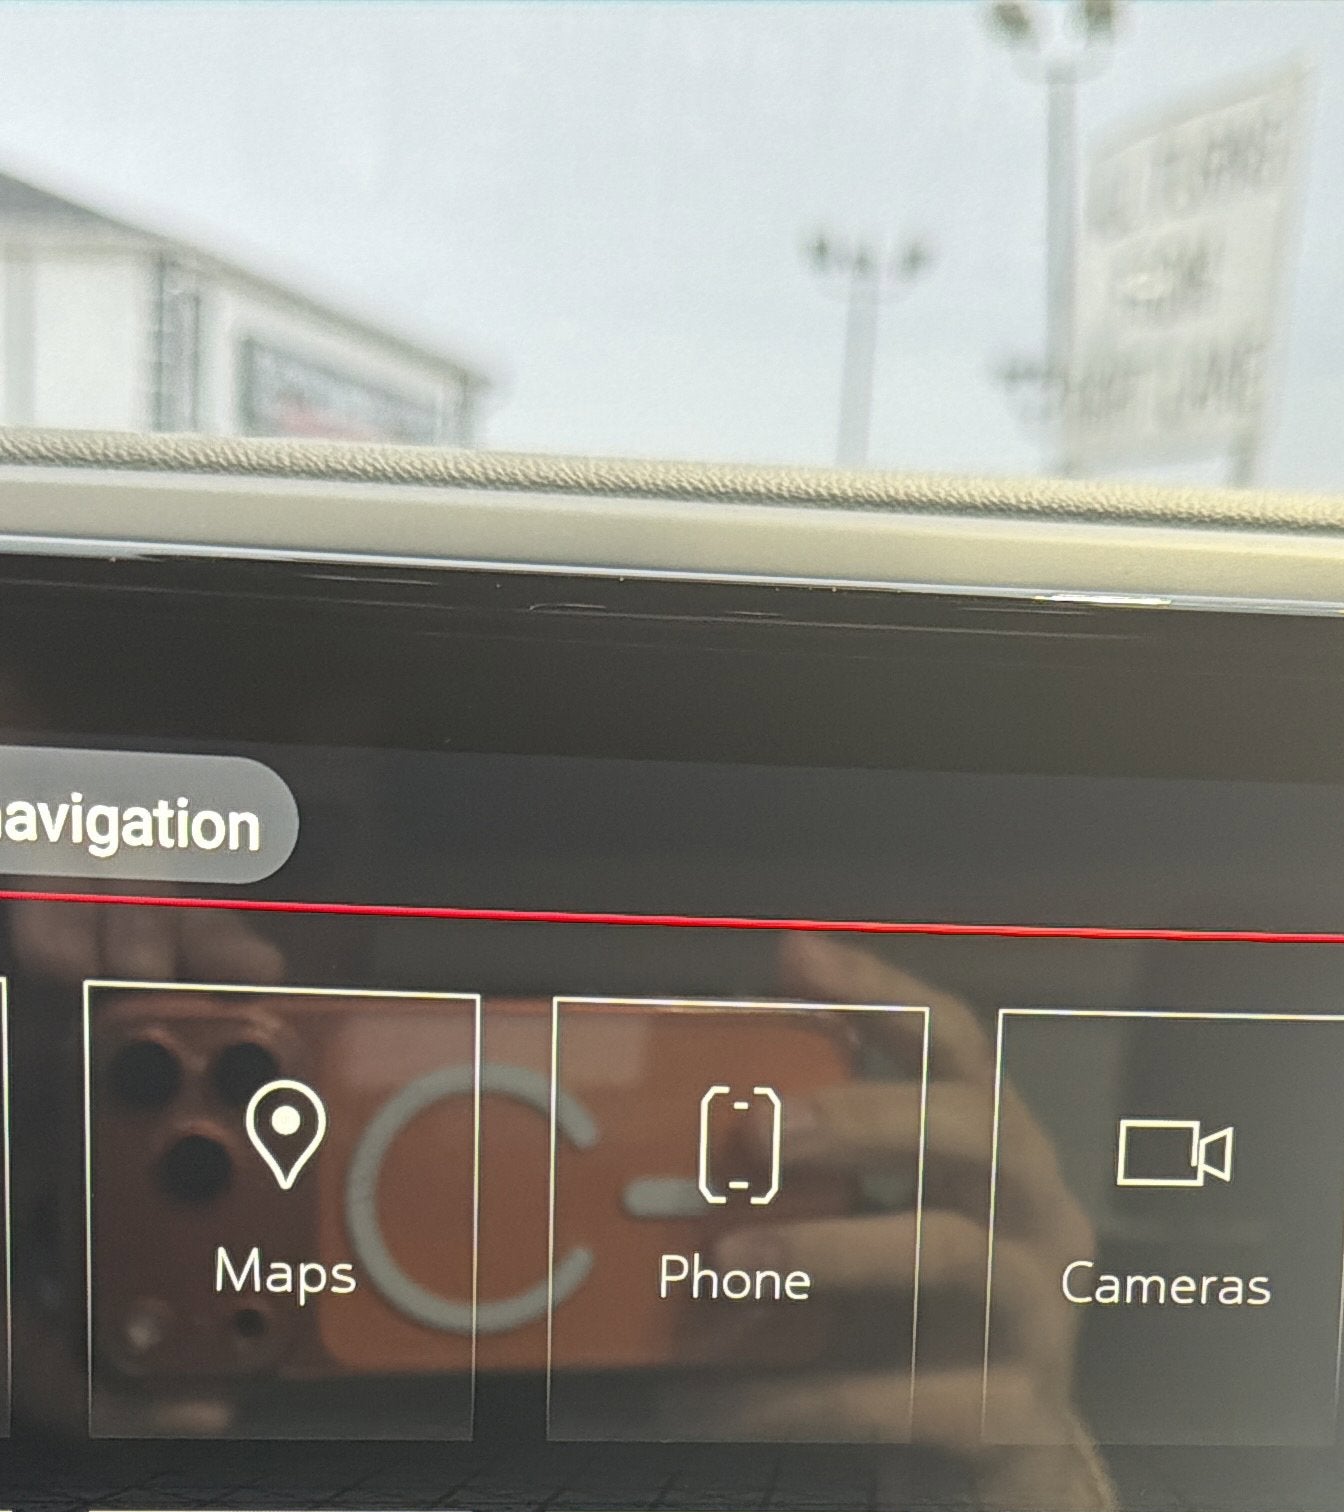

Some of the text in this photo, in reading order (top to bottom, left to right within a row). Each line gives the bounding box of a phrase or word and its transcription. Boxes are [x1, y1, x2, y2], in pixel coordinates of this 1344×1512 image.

[215, 1246, 357, 1307] Maps
[660, 1252, 811, 1300] Phone
[1062, 1260, 1271, 1305] Cameras
